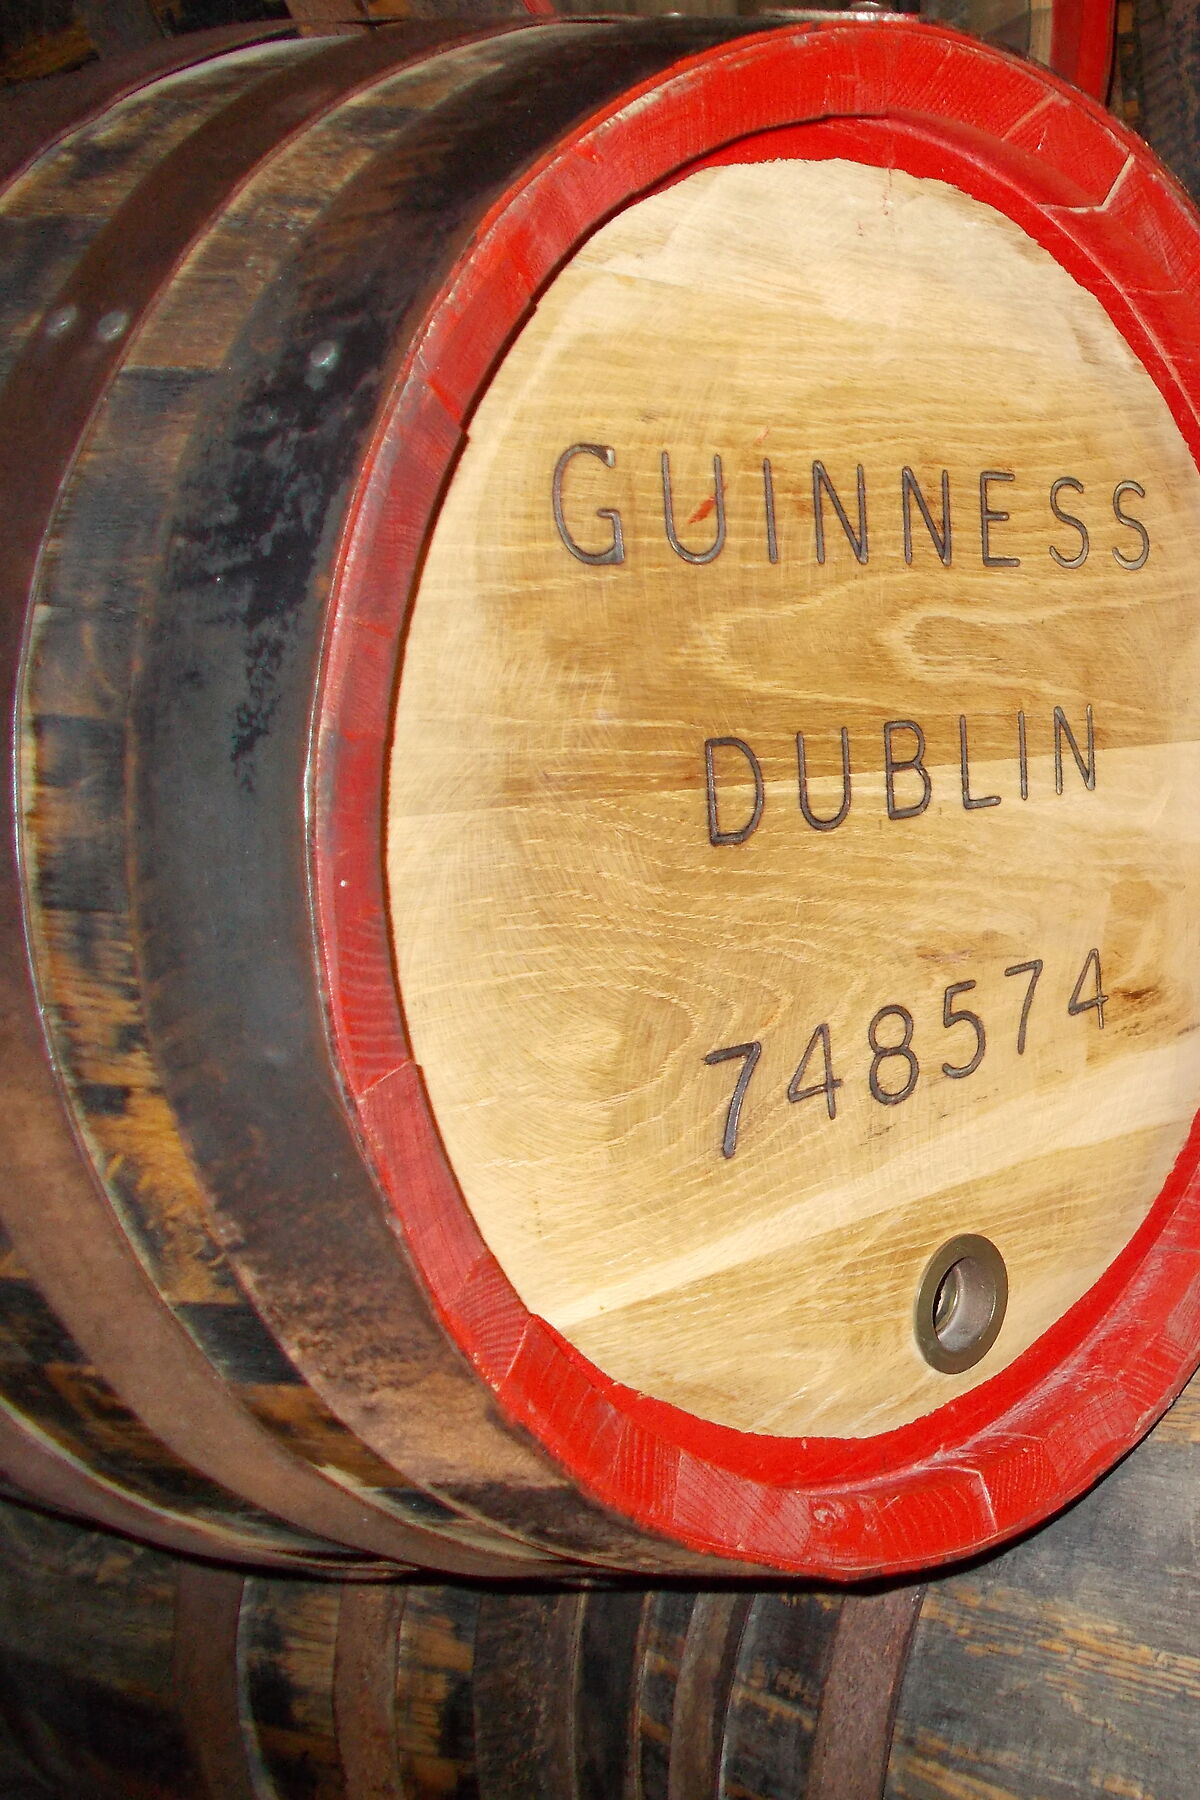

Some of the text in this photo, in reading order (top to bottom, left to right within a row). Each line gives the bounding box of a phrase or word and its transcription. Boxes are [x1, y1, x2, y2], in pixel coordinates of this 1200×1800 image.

[552, 443, 1150, 571] GUINNESS
[704, 704, 1097, 846] DUBLIN
[704, 948, 1109, 1158] 748574
